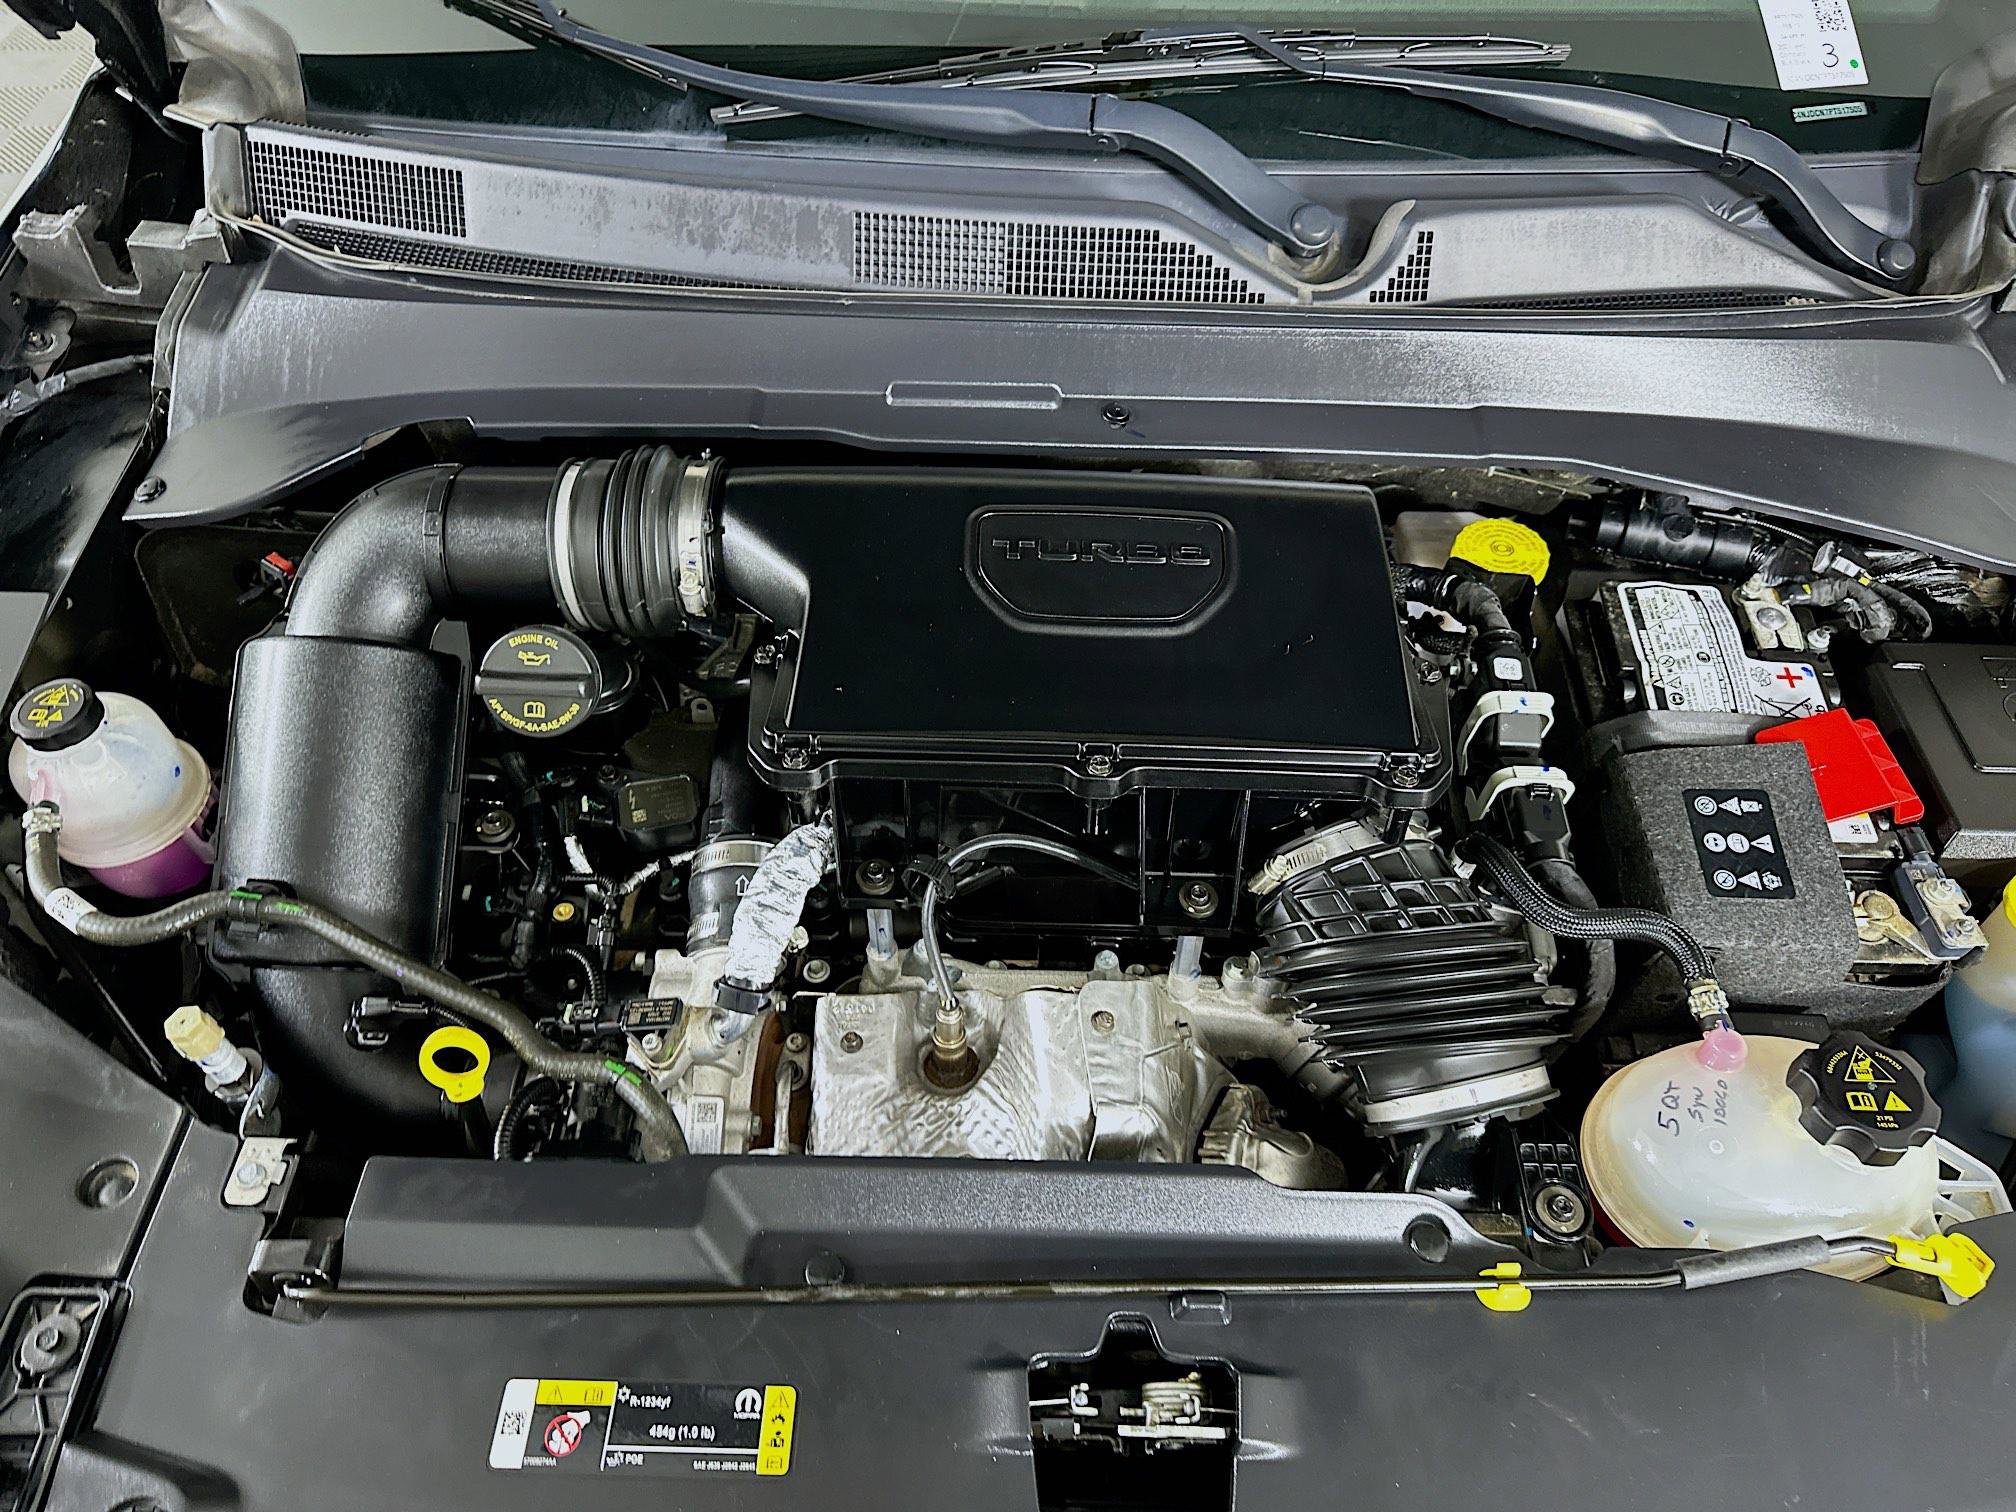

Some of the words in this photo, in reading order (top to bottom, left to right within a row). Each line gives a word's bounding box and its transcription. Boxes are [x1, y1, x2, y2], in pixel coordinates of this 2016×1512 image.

[1821, 43, 1839, 68] 3
[992, 538, 1211, 566] TURBO
[508, 634, 543, 648] ENGINE
[544, 637, 559, 650] OIL
[1656, 1111, 1680, 1137] 5
[649, 1424, 676, 1441] 454g
